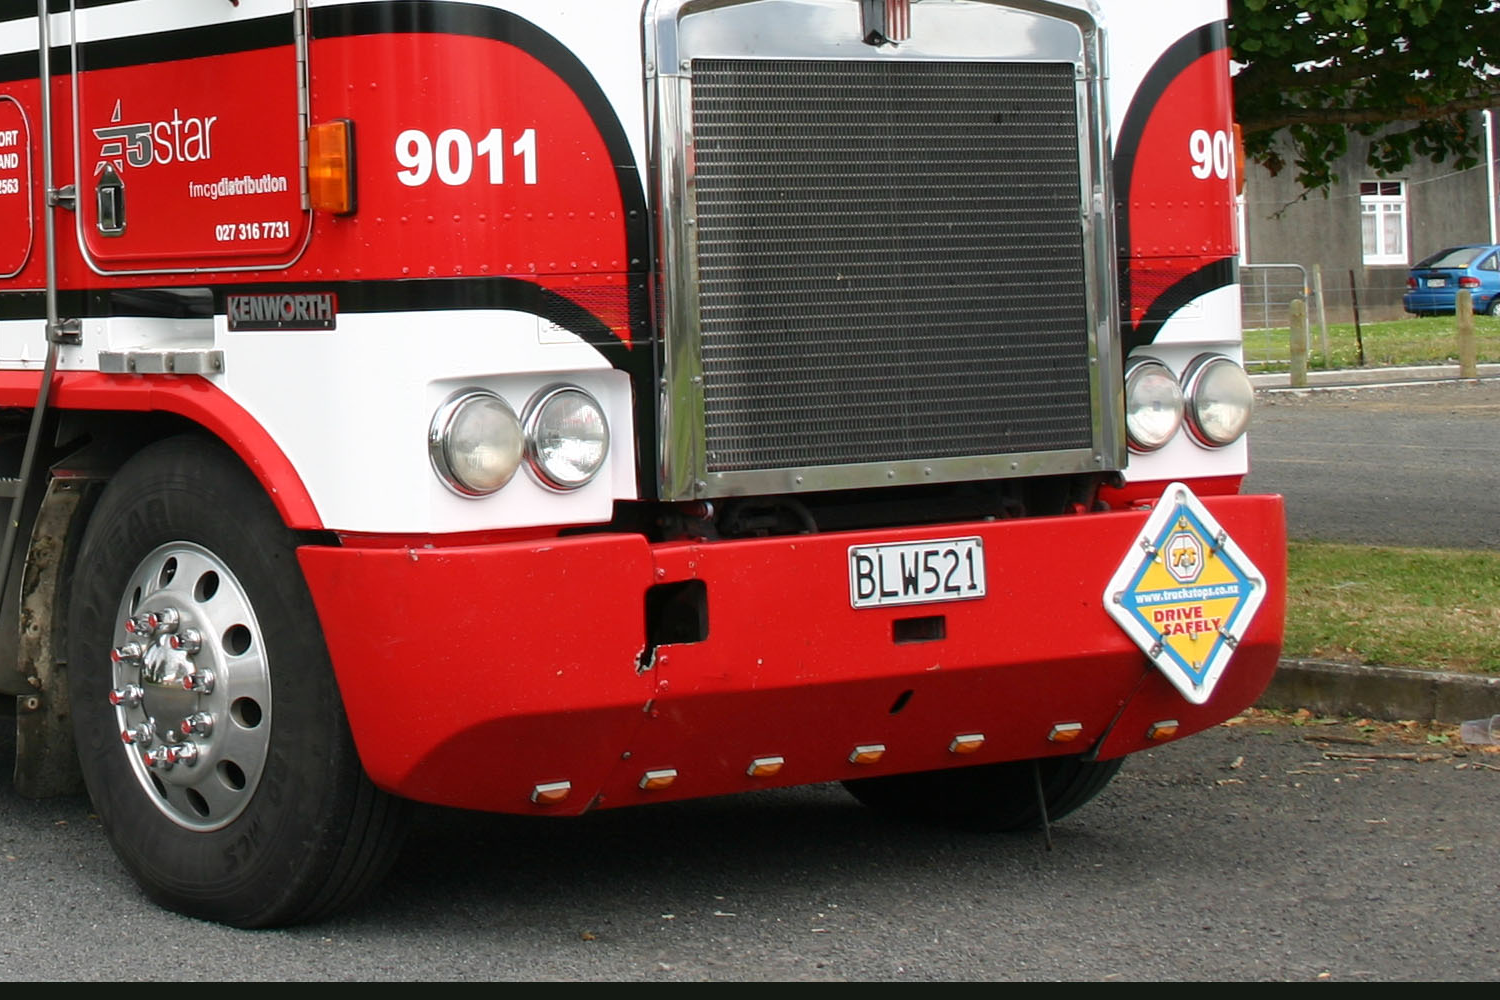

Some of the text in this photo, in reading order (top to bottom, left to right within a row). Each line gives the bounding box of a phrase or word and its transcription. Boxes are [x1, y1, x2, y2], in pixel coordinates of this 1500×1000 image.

[394, 127, 539, 187] 9011
[188, 173, 288, 200] fmcgdistribution
[215, 220, 290, 242] 027 316 7731
[227, 294, 333, 321] KENWORTH
[856, 546, 978, 600] BLW521
[1134, 585, 1240, 604] www.truckstops.co.nz
[1153, 605, 1203, 623] DRIVE
[1163, 617, 1221, 636] SAFELY
